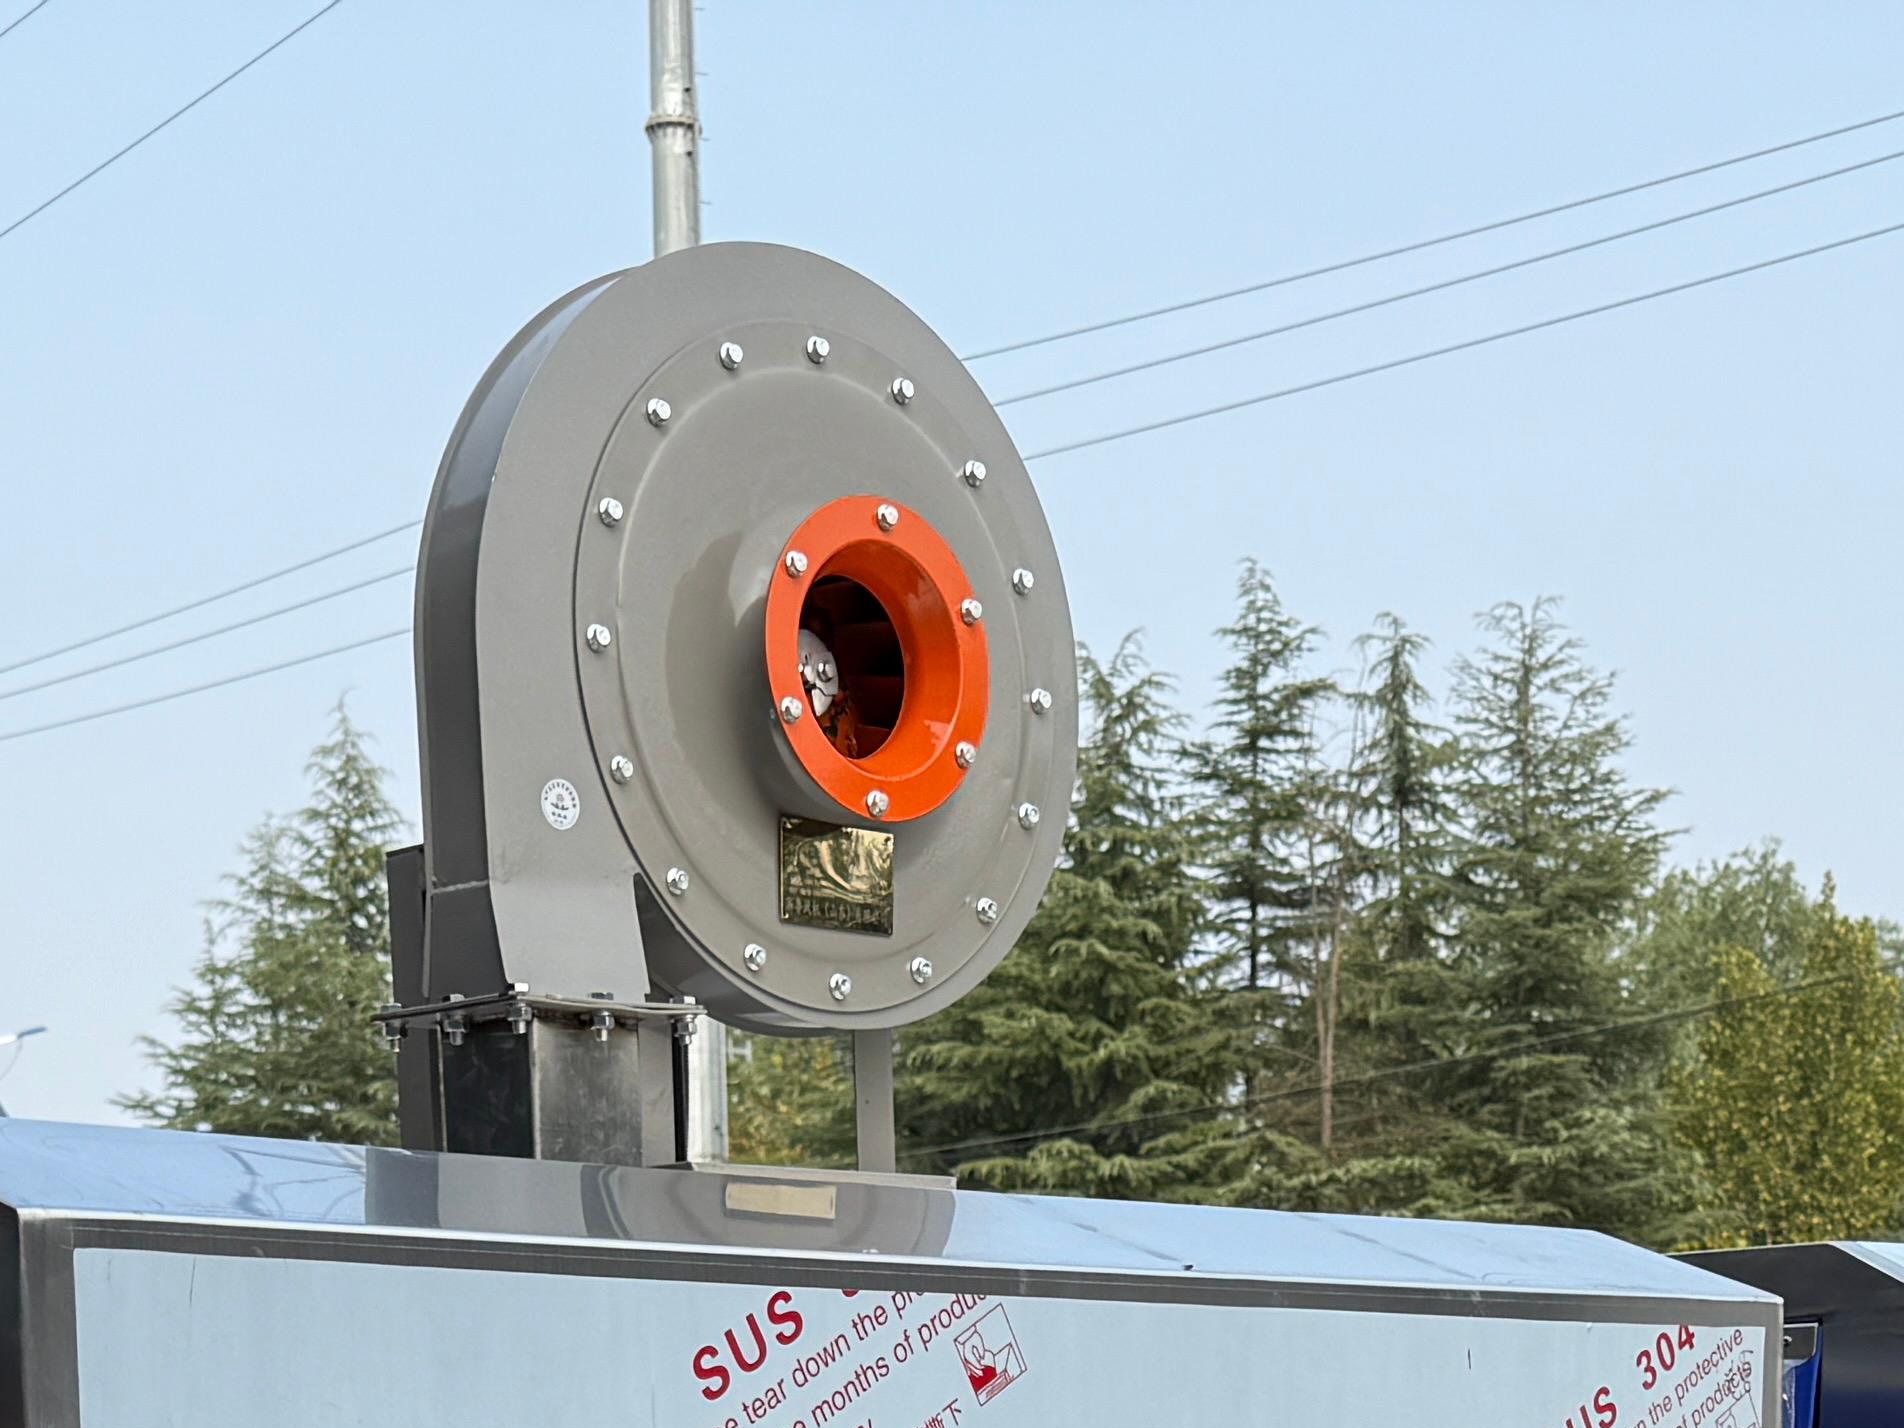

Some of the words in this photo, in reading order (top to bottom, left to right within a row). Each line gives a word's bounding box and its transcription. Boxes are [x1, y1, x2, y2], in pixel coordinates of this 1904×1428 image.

[693, 1291, 802, 1400] SUS
[742, 1379, 786, 1424] tear
[792, 1334, 850, 1387] down
[852, 1306, 888, 1341] the
[892, 1291, 925, 1319] pr
[812, 1357, 889, 1427] months
[894, 1329, 913, 1362] of
[918, 1294, 986, 1351] produ
[1636, 1324, 1696, 1390] 304
[1649, 1396, 1672, 1425] the
[1675, 1329, 1743, 1406] protective
